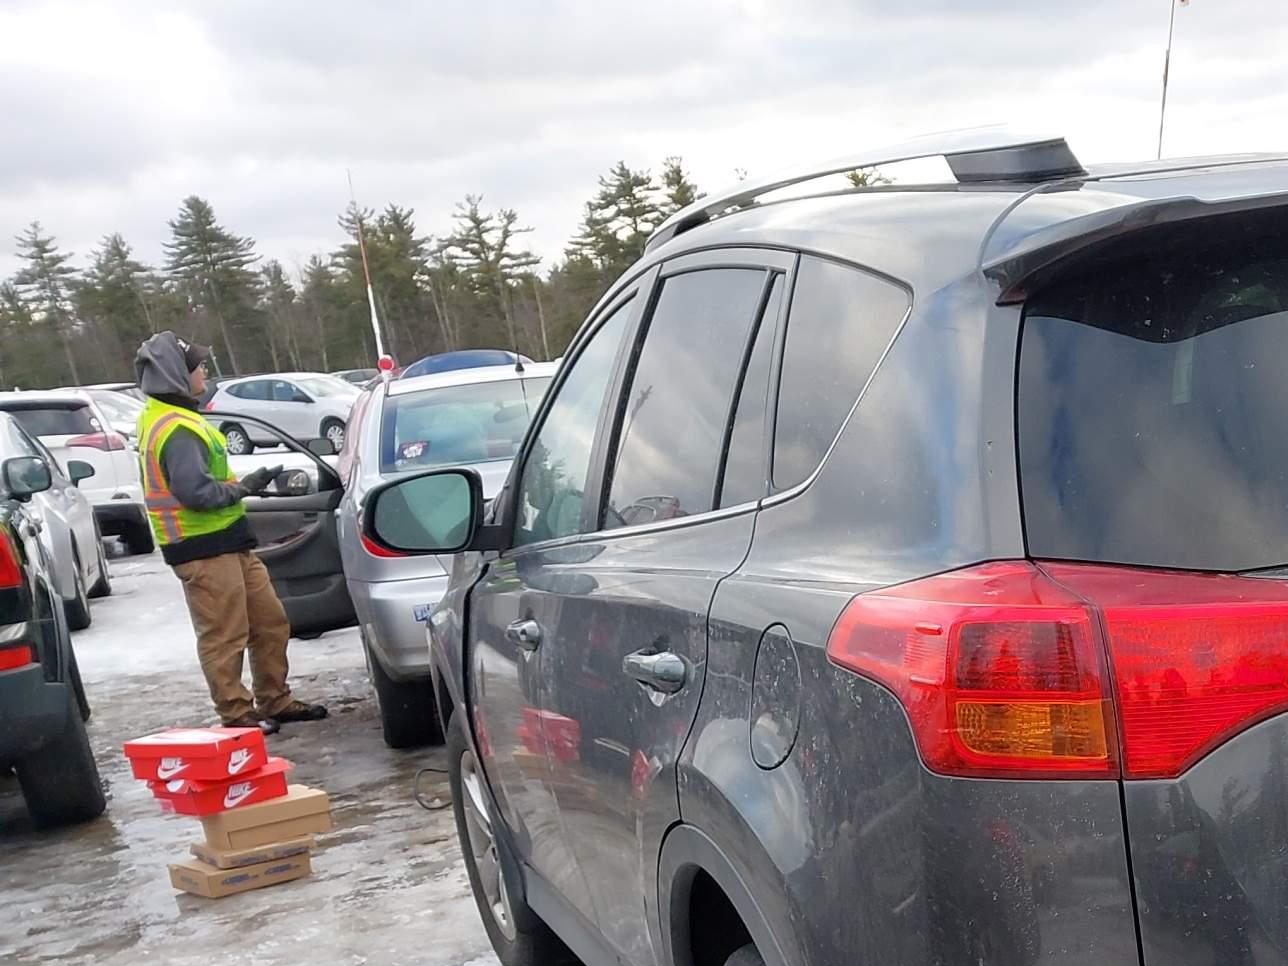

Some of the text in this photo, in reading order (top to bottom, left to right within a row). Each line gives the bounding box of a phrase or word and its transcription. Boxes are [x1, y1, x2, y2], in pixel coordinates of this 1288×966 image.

[161, 757, 183, 769] NIKE
[231, 748, 249, 764] NIKE
[228, 782, 251, 797] NIKE
